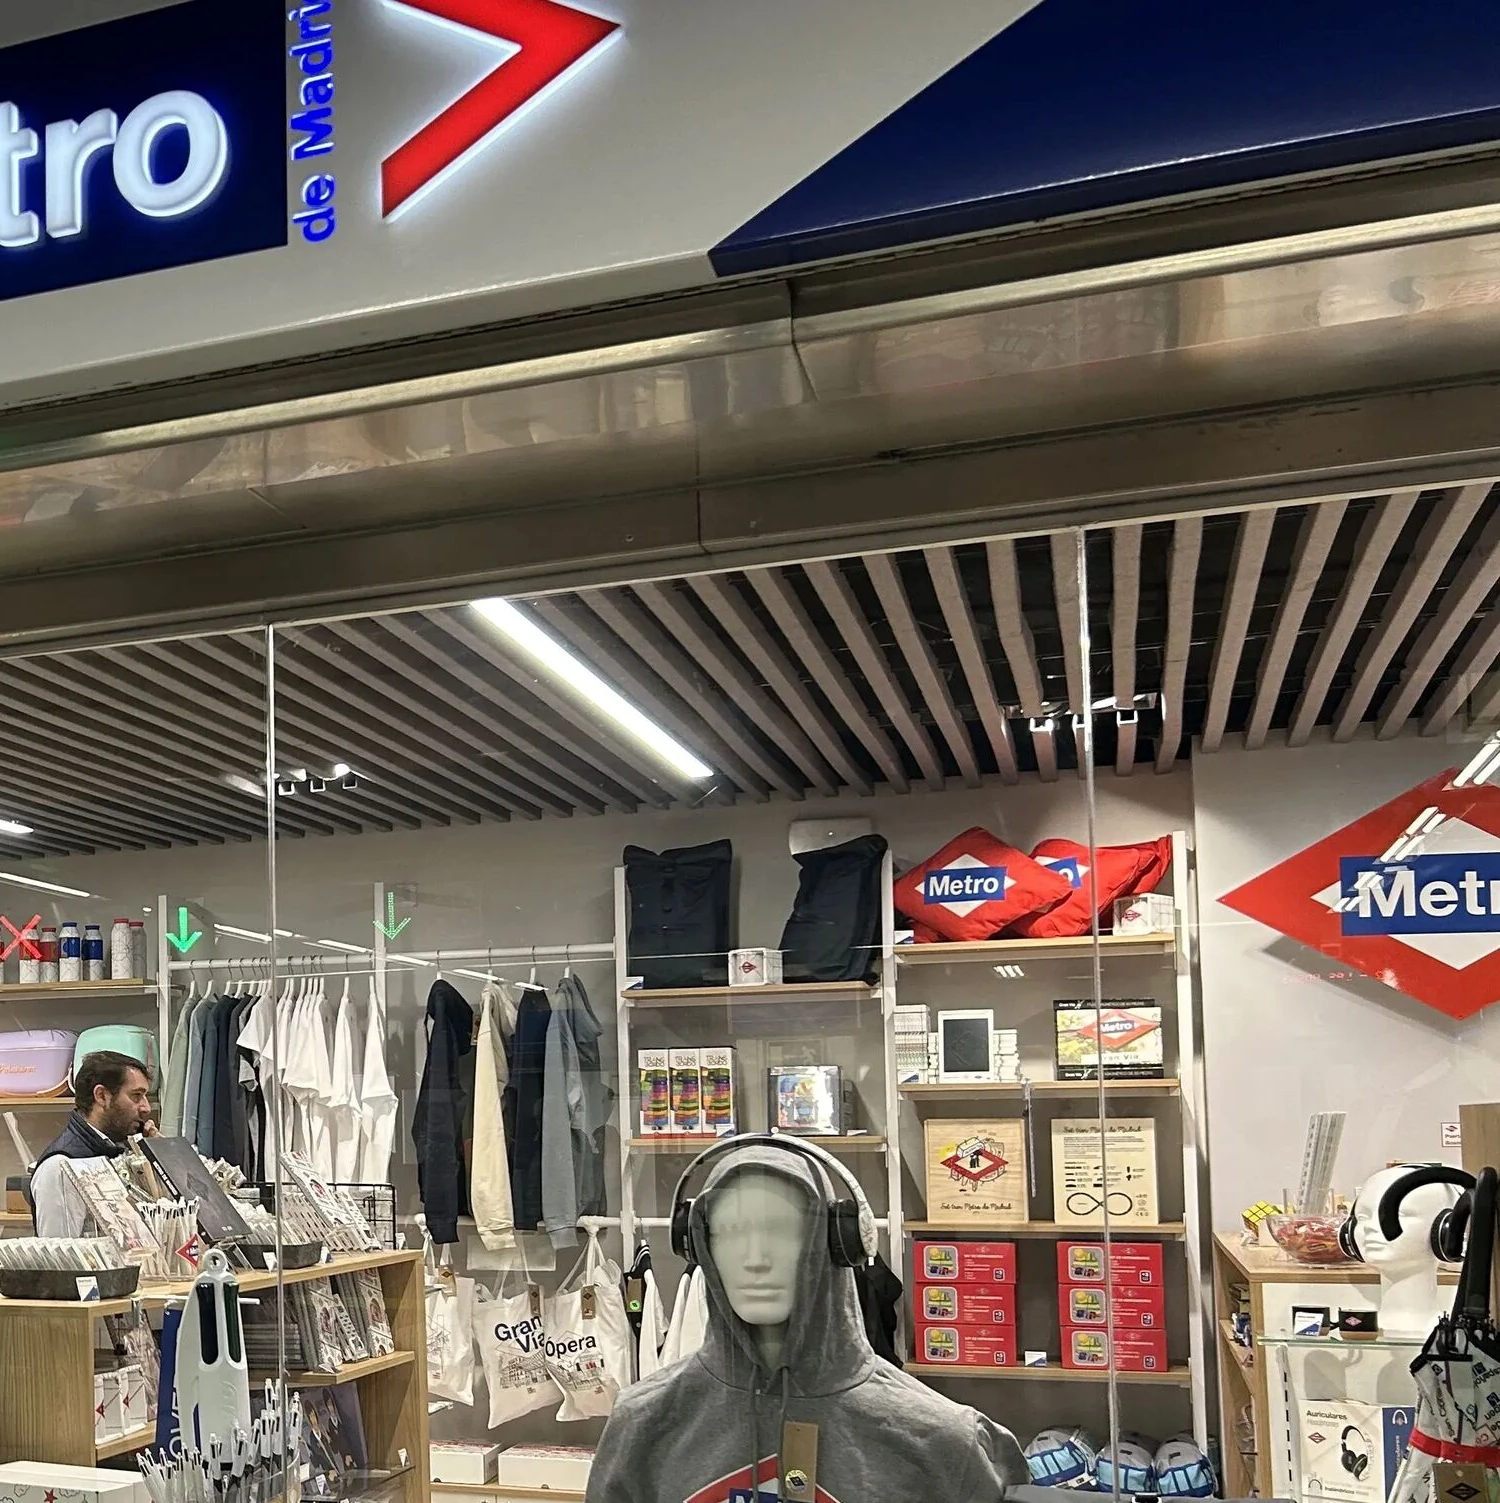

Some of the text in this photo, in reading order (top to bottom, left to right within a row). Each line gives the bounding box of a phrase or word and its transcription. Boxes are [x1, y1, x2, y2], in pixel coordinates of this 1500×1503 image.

[288, 0, 336, 243] de Madri
[928, 875, 999, 897] Metro
[494, 1316, 542, 1341] Gran
[516, 1330, 545, 1354] Vía
[545, 1335, 597, 1359] Ópera
[1306, 1409, 1348, 1421] Auriculares
